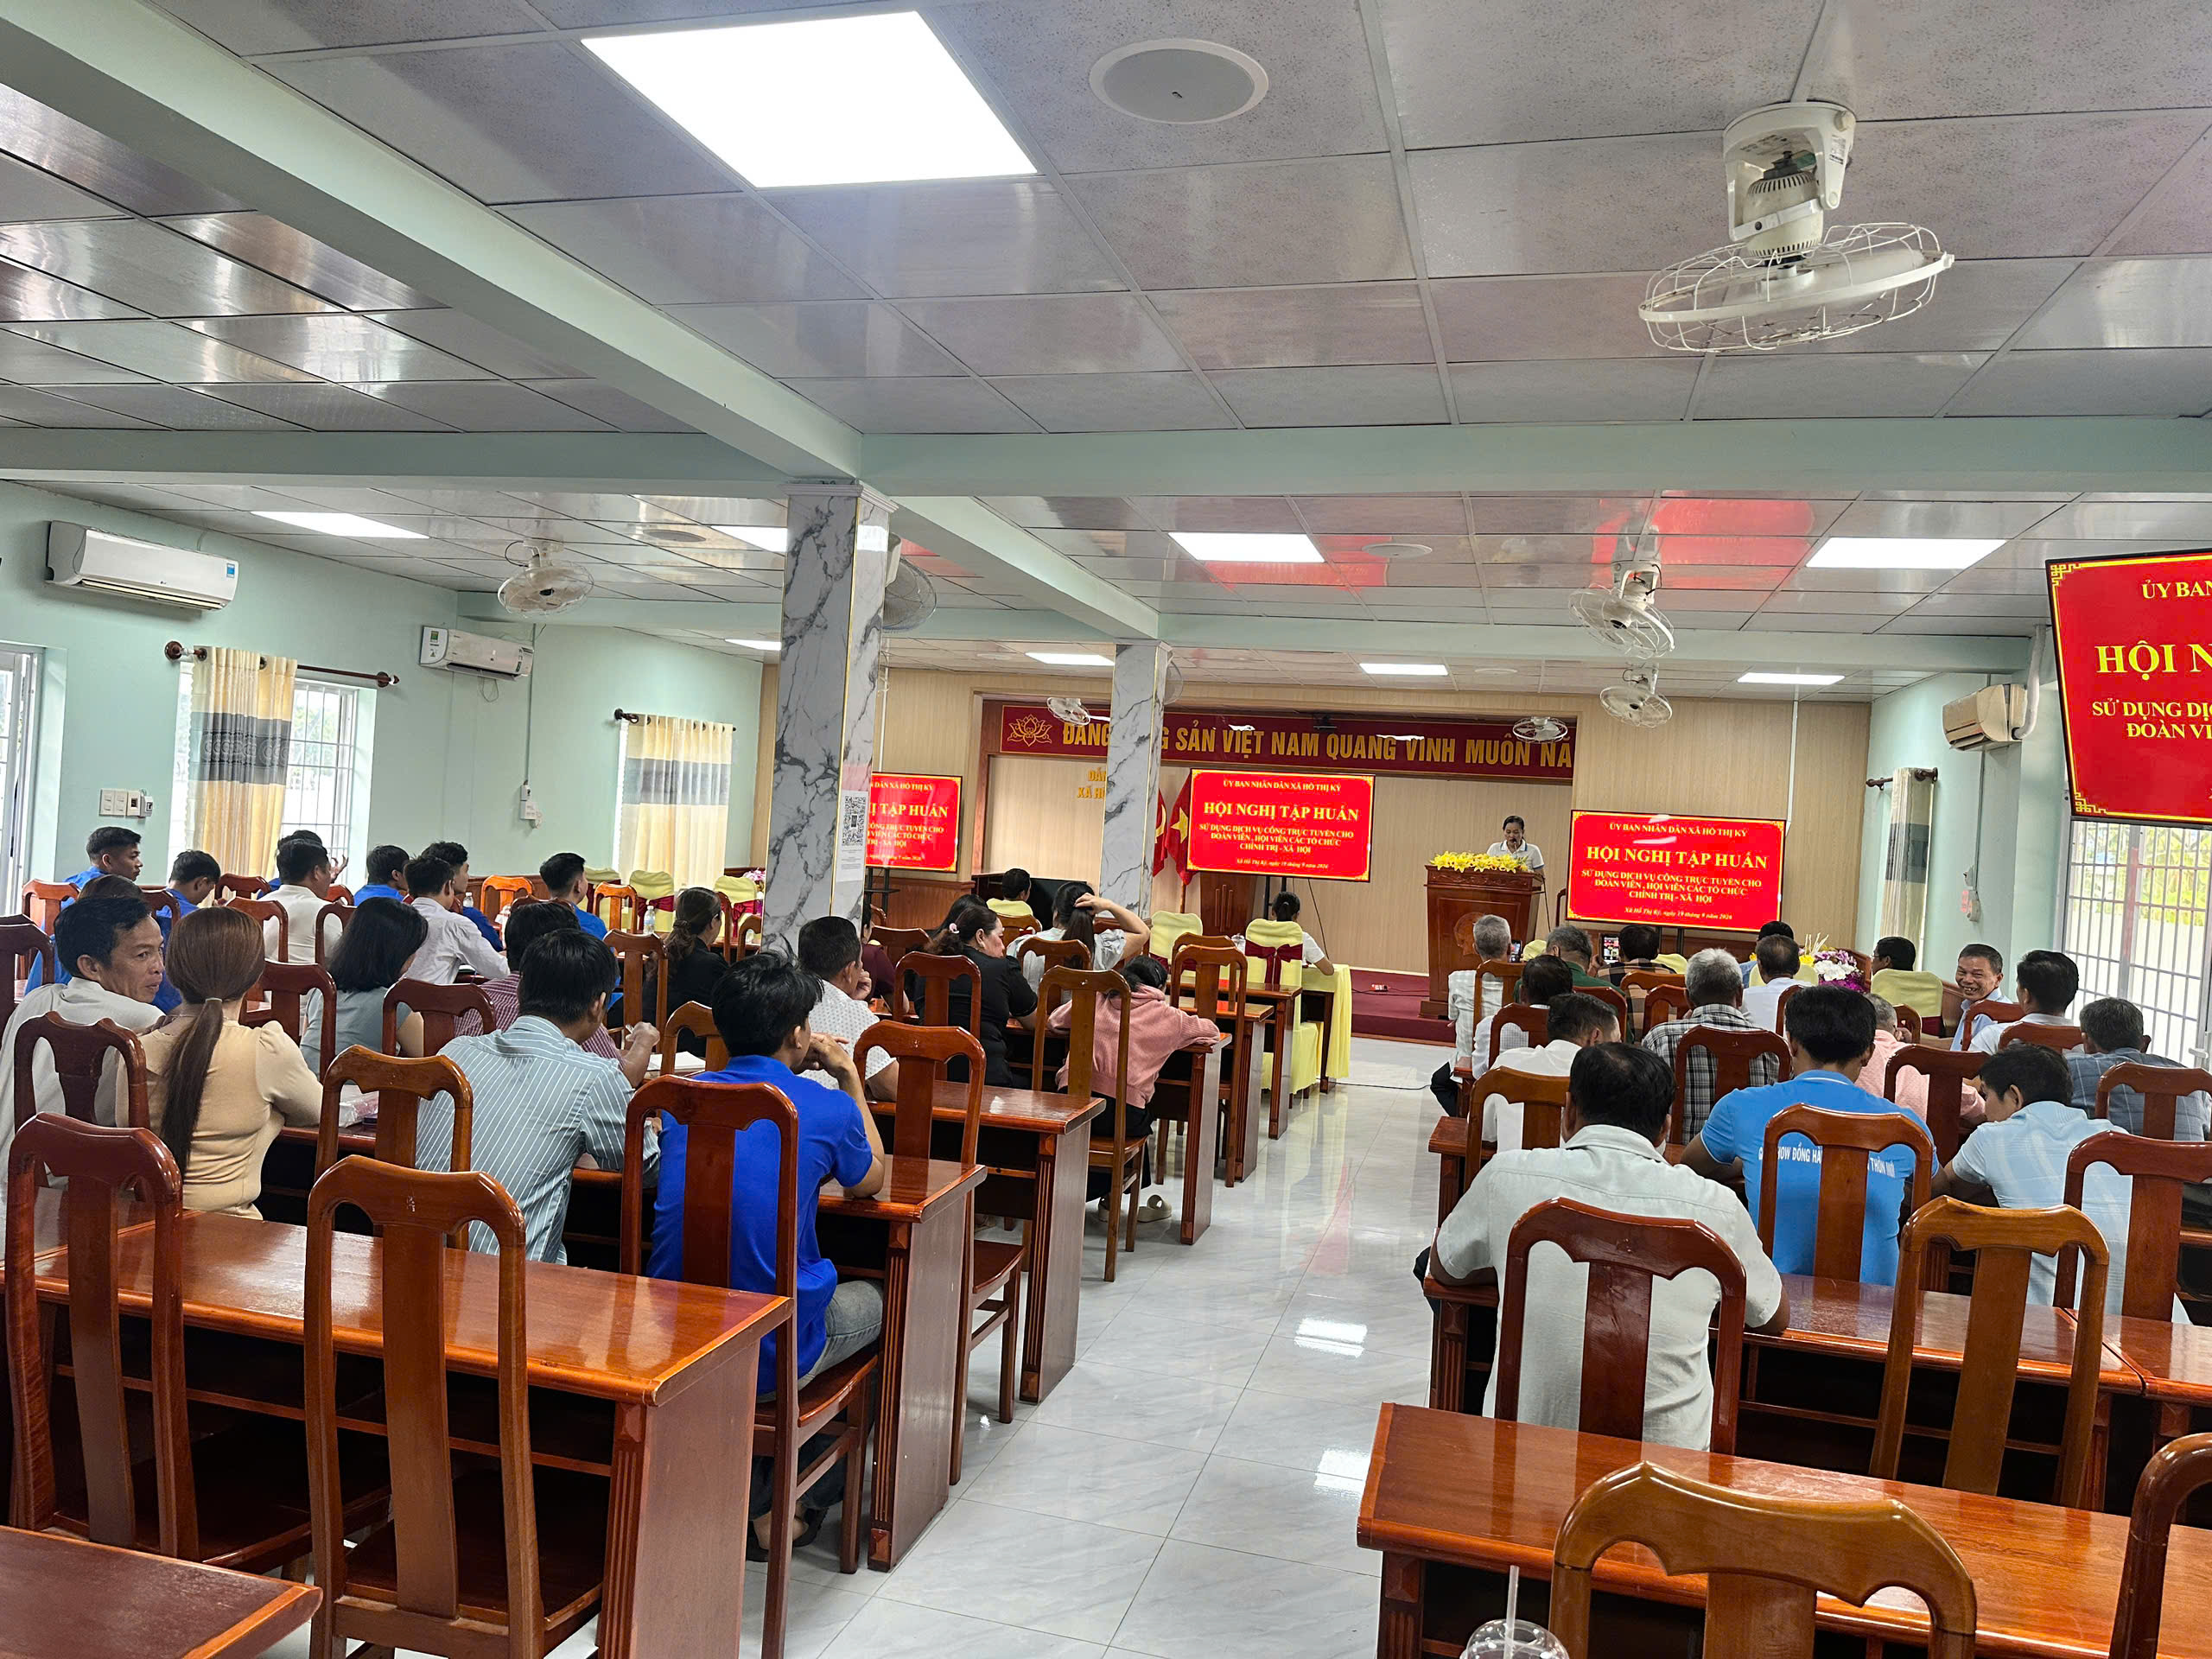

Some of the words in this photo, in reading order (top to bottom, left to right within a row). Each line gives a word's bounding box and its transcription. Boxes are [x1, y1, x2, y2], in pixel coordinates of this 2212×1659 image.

[2142, 579, 2171, 599] ỦY
[2094, 640, 2177, 681] HỘI
[2092, 697, 2120, 716] SỬ
[2122, 702, 2183, 721] DỤNG
[2126, 720, 2185, 739] ĐOÀN
[1175, 720, 1216, 753] SẢN
[1223, 728, 1264, 759] VIỆT
[1271, 732, 1319, 757] NAM
[1326, 733, 1396, 760] QUANG
[1406, 736, 1456, 763] VINH
[1465, 732, 1530, 766] MUÔN
[880, 802, 906, 817] TẬP
[909, 803, 948, 817] HUẤN
[1204, 800, 1232, 818] HỘI
[1236, 803, 1275, 820] NGHỊ
[1280, 804, 1311, 821] TẬP
[1313, 804, 1359, 821] HUẤN
[1336, 830, 1354, 838] CHO
[1642, 823, 1667, 832] NHÂN
[1669, 824, 1687, 834] DÂN
[1586, 845, 1620, 863] HỘI
[1624, 848, 1671, 867] NGHỊ
[1675, 850, 1712, 868] TẬP
[1714, 851, 1767, 869] HUẤN
[1646, 882, 1662, 891] HỘI
[1720, 886, 1748, 895] CHỨC
[1657, 873, 1683, 882] CÔNG
[1741, 879, 1762, 887] CHO
[1629, 890, 1657, 899] CHÍNH
[1659, 893, 1674, 902] TRỊ
[1695, 894, 1713, 904] HỘI
